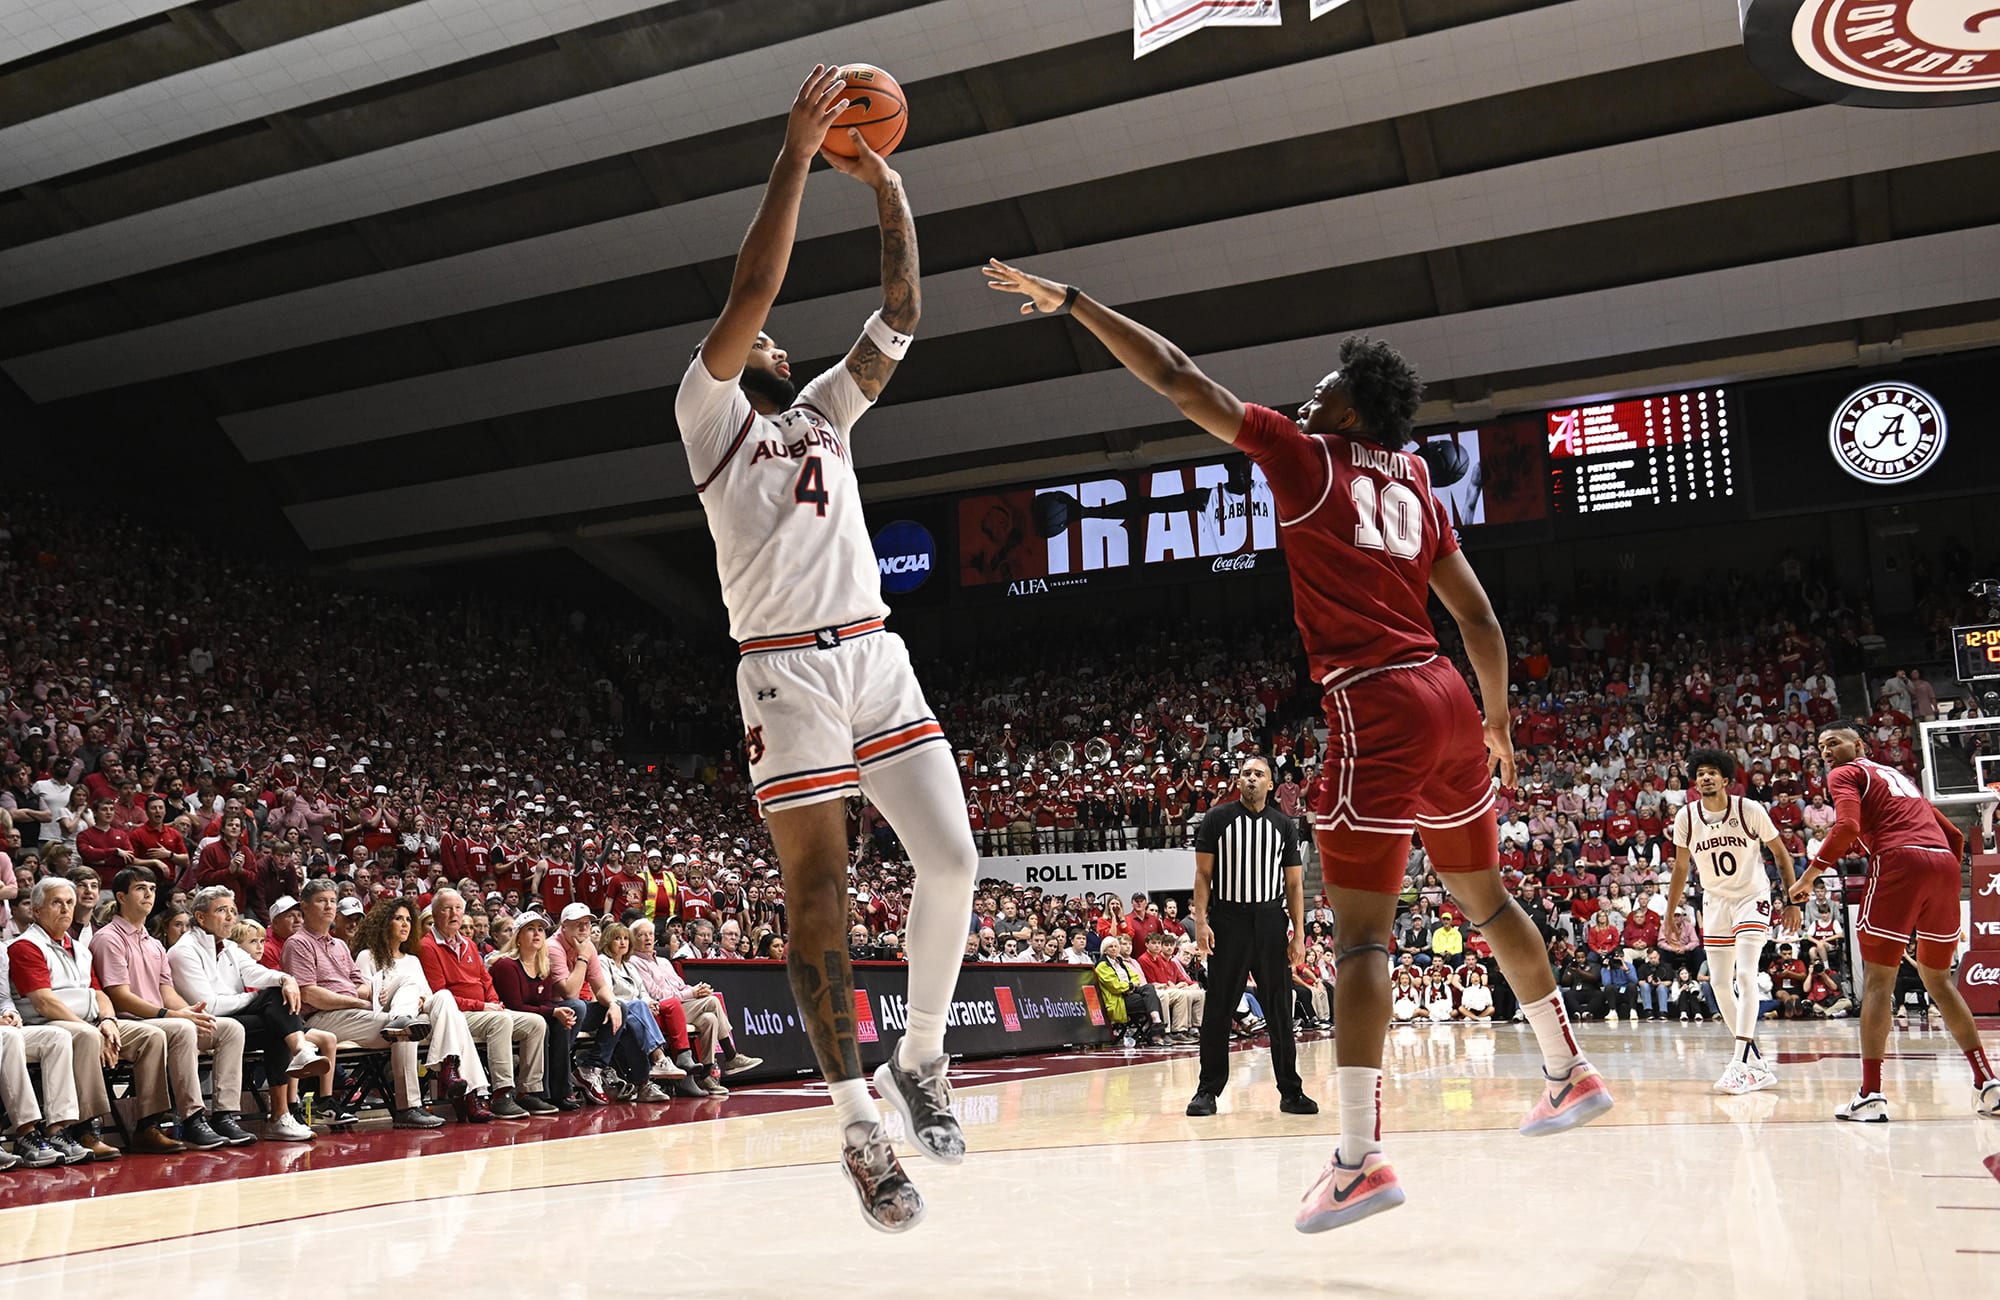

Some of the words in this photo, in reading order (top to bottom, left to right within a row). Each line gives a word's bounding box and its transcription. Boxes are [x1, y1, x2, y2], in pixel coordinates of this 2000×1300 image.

[1861, 38, 1988, 74] TIDE
[1842, 391, 1932, 432] ALABAMA
[749, 426, 846, 467] AUBURN
[1843, 440, 1906, 473] CRIMSON
[1905, 433, 1935, 465] TIDE
[794, 455, 829, 518] 4
[1351, 475, 1422, 562] 10
[879, 553, 930, 575] NCAA
[1007, 578, 1049, 597] ALFA
[1049, 578, 1088, 588] INSURANCE
[1695, 836, 1748, 854] AUBURN
[1026, 866, 1077, 883] ROLL
[1082, 863, 1127, 881] TIDE
[1711, 851, 1737, 877] 10
[743, 1006, 783, 1035] Auto
[879, 994, 908, 1031] Alf
[1017, 997, 1038, 1020] Life
[1043, 996, 1087, 1018] Business
